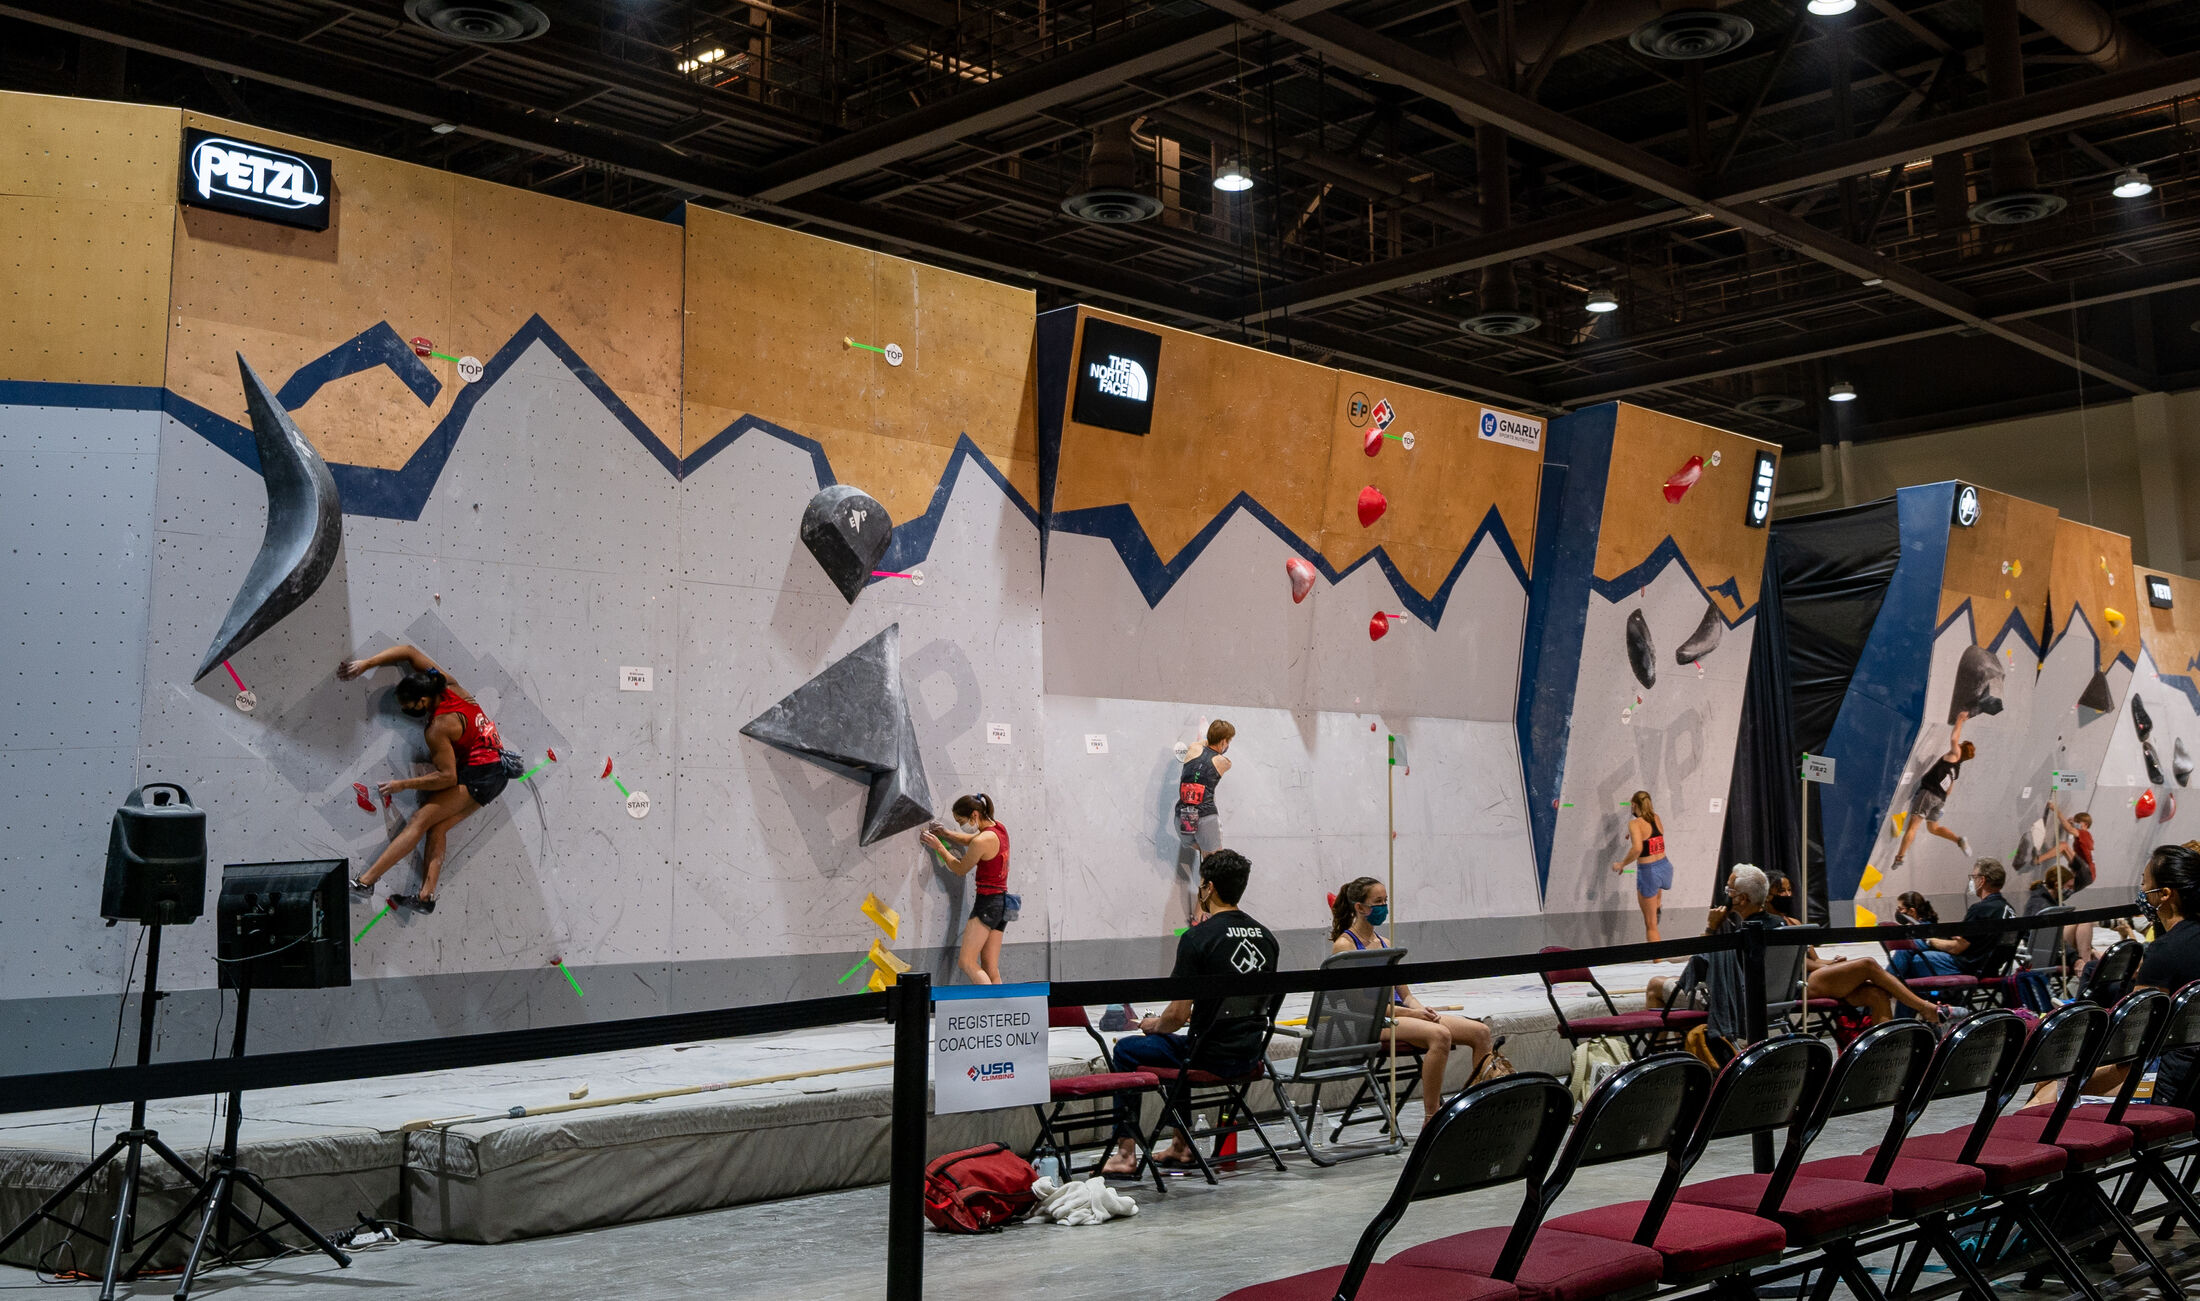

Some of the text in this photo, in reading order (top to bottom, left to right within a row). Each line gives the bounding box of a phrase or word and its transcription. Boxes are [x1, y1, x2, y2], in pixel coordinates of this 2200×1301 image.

[199, 145, 324, 205] PETZL
[886, 350, 902, 359] TOP
[459, 364, 482, 375] TOP
[1109, 355, 1131, 372] THE
[1090, 363, 1129, 384] NORTH
[1099, 379, 1128, 397] FACE
[1499, 420, 1540, 439] GNARLY
[1754, 460, 1774, 520] CLIF
[237, 695, 256, 707] ZONE
[627, 801, 649, 809] START
[1226, 927, 1263, 938] JUDGE
[948, 1012, 1030, 1031] REGISTERED
[938, 1031, 1040, 1053] COACHES ONLY
[981, 1062, 1014, 1075] USA
[981, 1073, 1015, 1082] CLIMBING
